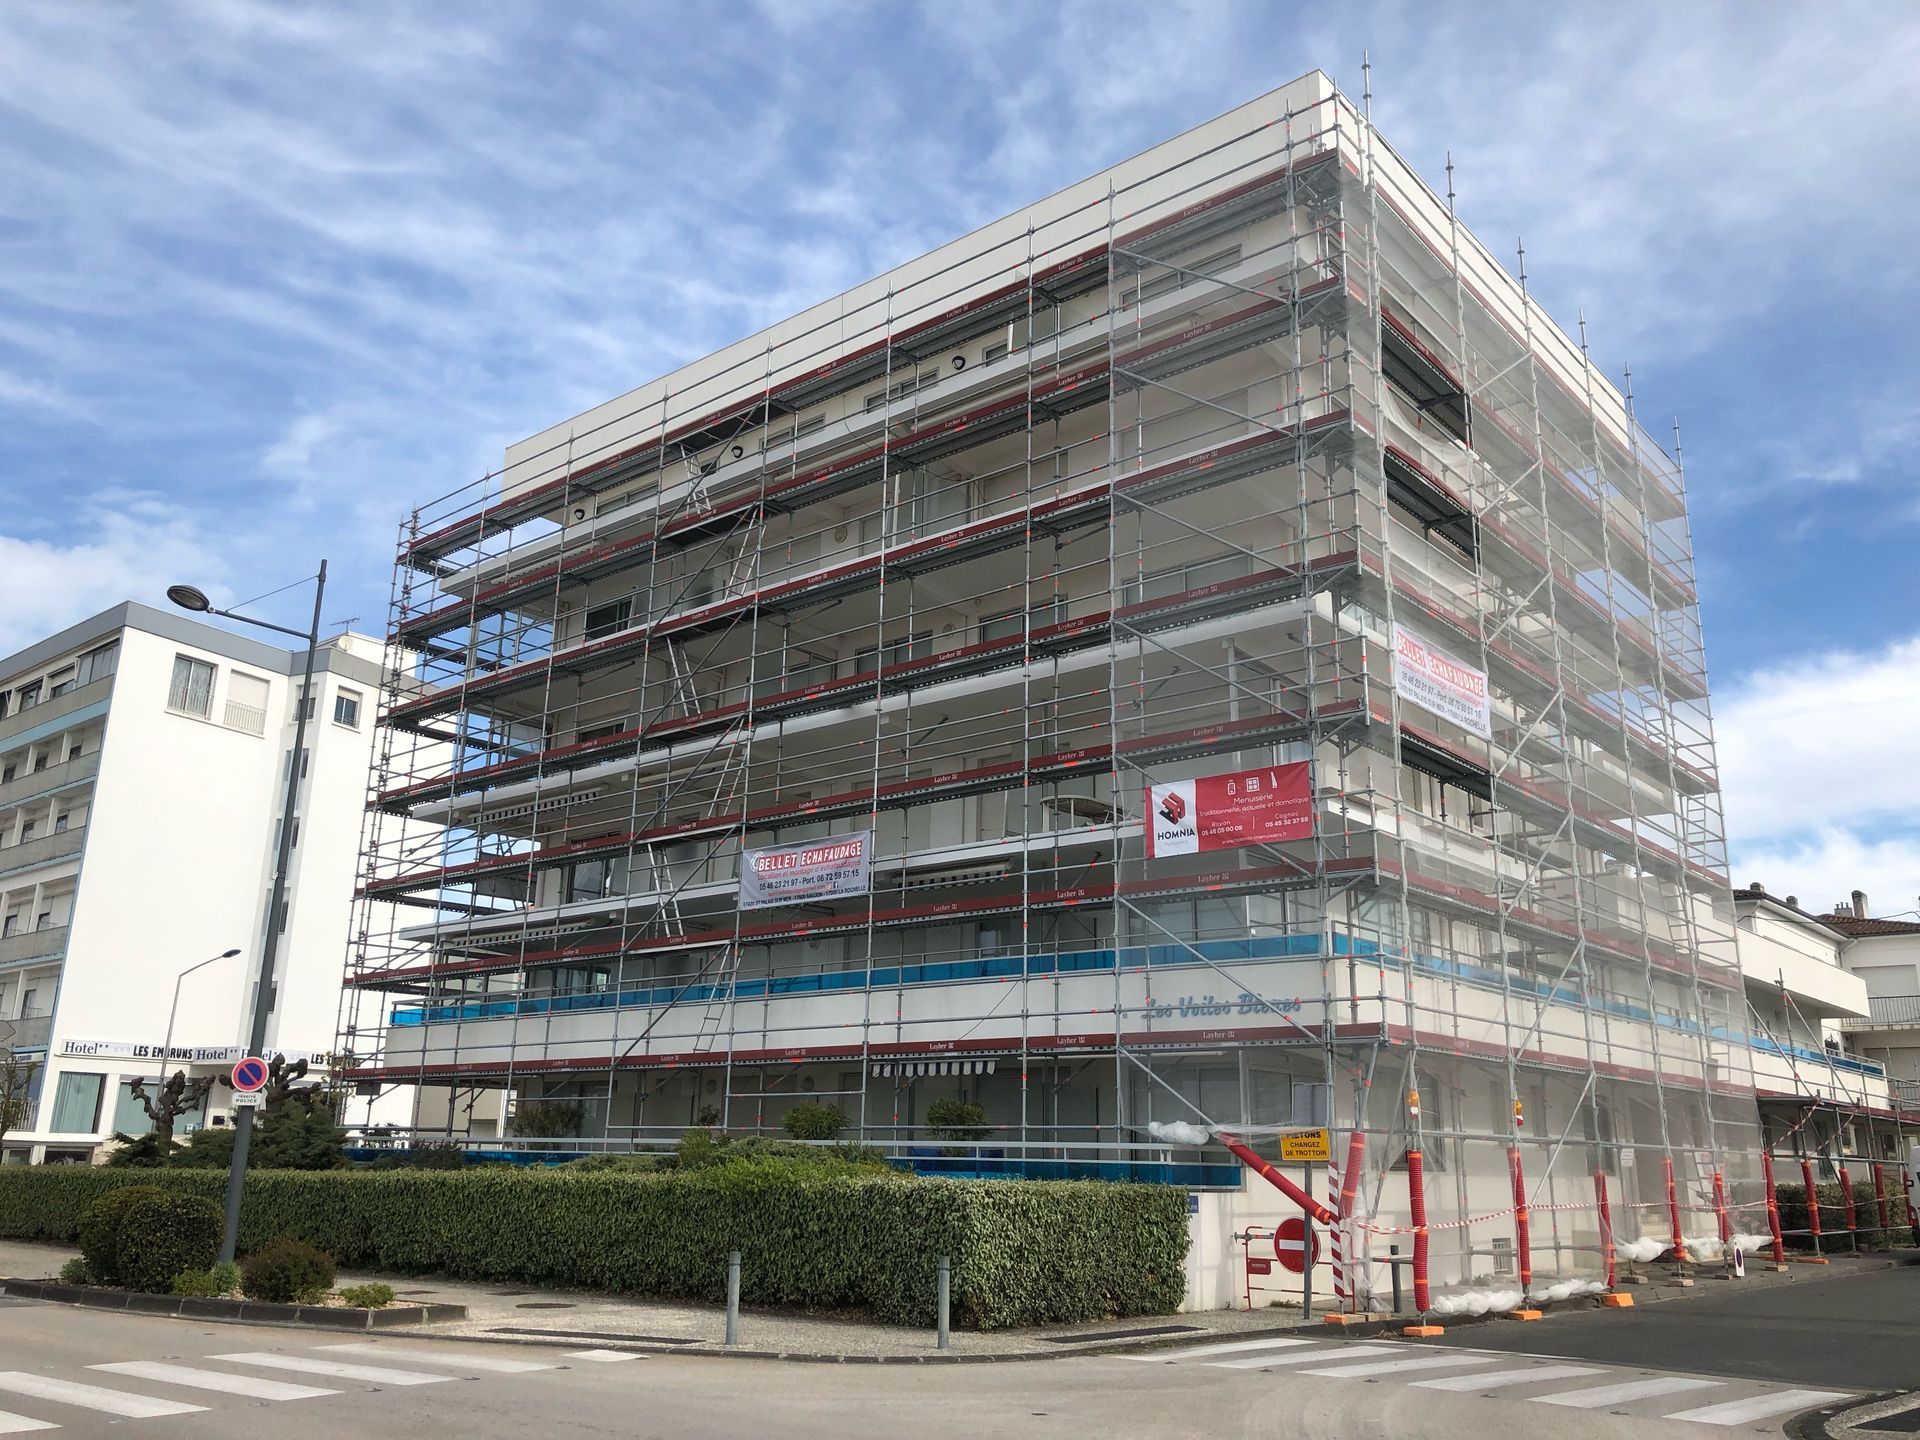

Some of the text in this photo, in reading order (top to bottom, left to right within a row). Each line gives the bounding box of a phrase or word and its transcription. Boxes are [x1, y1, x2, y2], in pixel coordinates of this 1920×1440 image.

[944, 418, 961, 429] Layher
[940, 533, 958, 544] Layher
[1057, 620, 1076, 631] Layher
[1193, 726, 1215, 737] Layher
[1057, 750, 1077, 762] Layher
[934, 774, 952, 783] Layher
[1233, 793, 1273, 804] Menuiserie
[798, 801, 814, 809] Layher
[1274, 811, 1299, 820] Cognac
[1157, 828, 1195, 840] HOMNIA
[757, 841, 863, 871] BELLET ECHAFAUDAGE
[767, 881, 774, 889] 46
[791, 878, 798, 886] 97
[817, 874, 824, 882] 06
[843, 870, 851, 878] 57
[852, 868, 860, 877] 15
[1198, 873, 1221, 883] Layher
[1057, 890, 1077, 899] Layher
[1057, 1036, 1078, 1045] Layher
[1203, 1030, 1226, 1040] Layher
[64, 1041, 99, 1055] Hotel
[133, 1045, 149, 1057] LES
[929, 1042, 948, 1050] Layher
[196, 1048, 228, 1060] Hotel
[311, 1053, 324, 1065] LES
[1285, 1149, 1327, 1157] DE TROTTOIR
